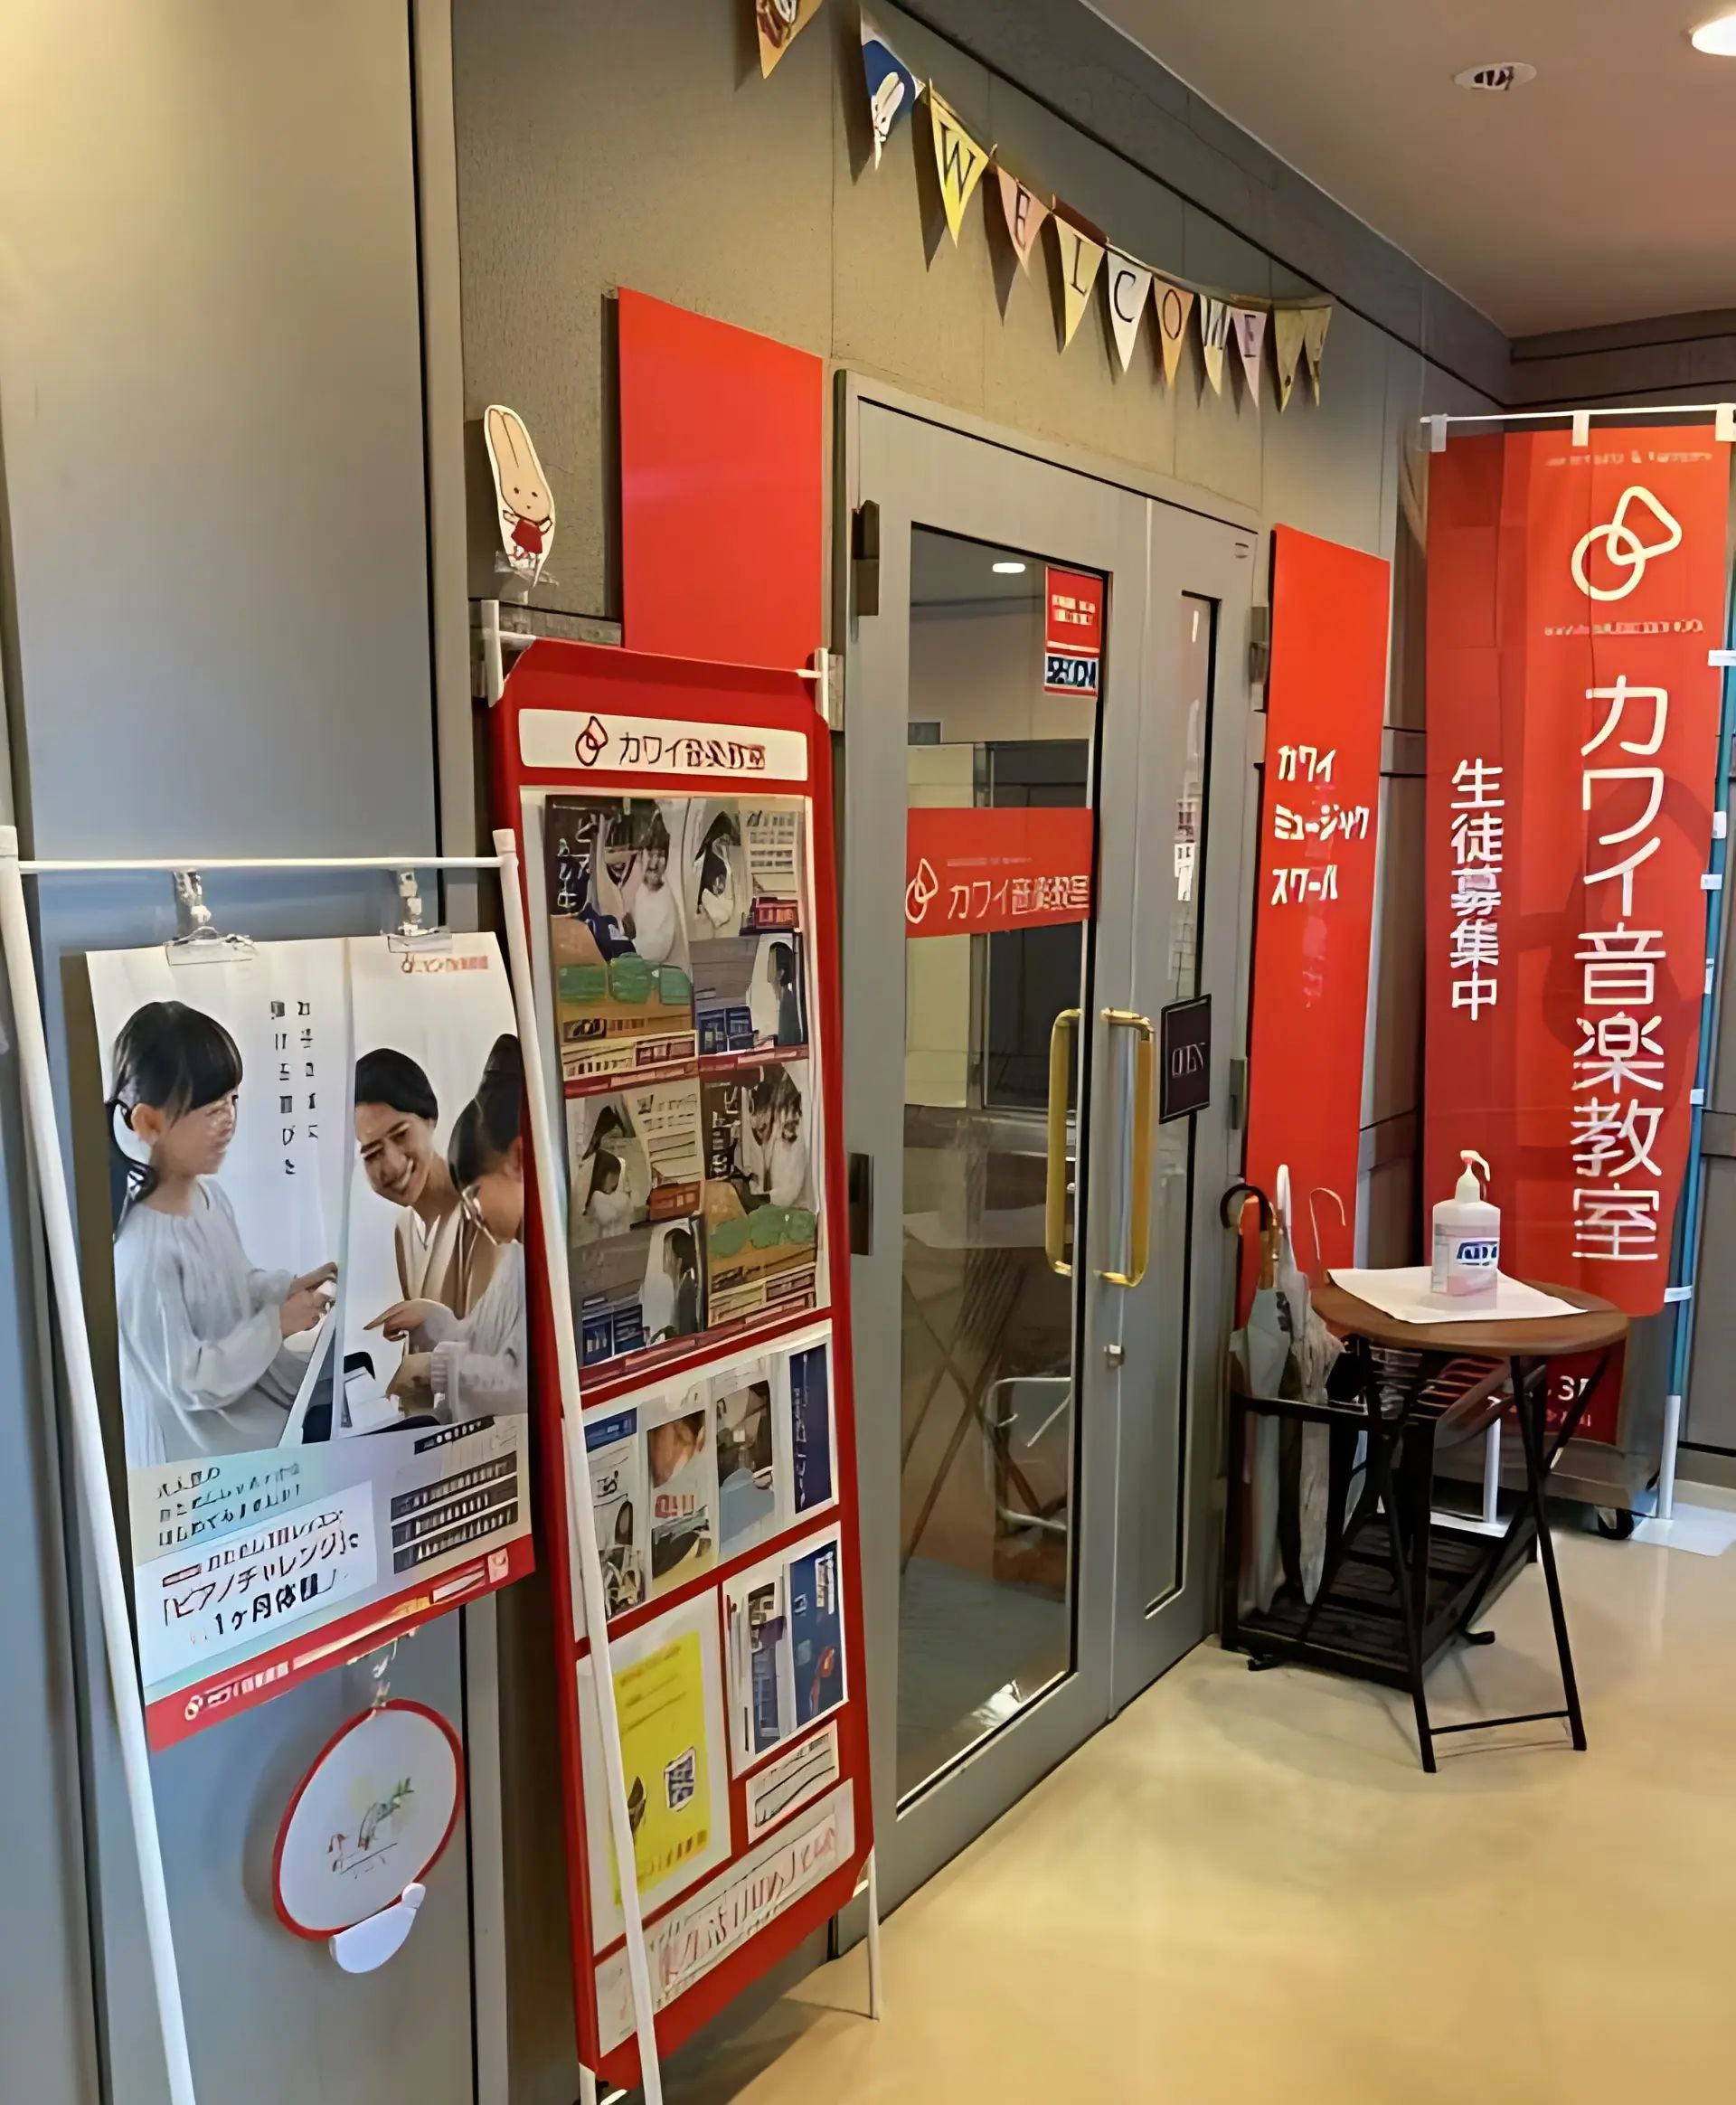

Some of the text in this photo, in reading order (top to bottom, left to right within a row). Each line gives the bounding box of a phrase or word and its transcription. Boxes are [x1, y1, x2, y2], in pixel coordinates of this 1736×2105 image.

[1274, 803, 1370, 841] ミュージック
[1277, 744, 1337, 783] カワイ
[1449, 758, 1505, 1021] 生徒募集中
[1571, 674, 1669, 1261] カワイ音楽教室
